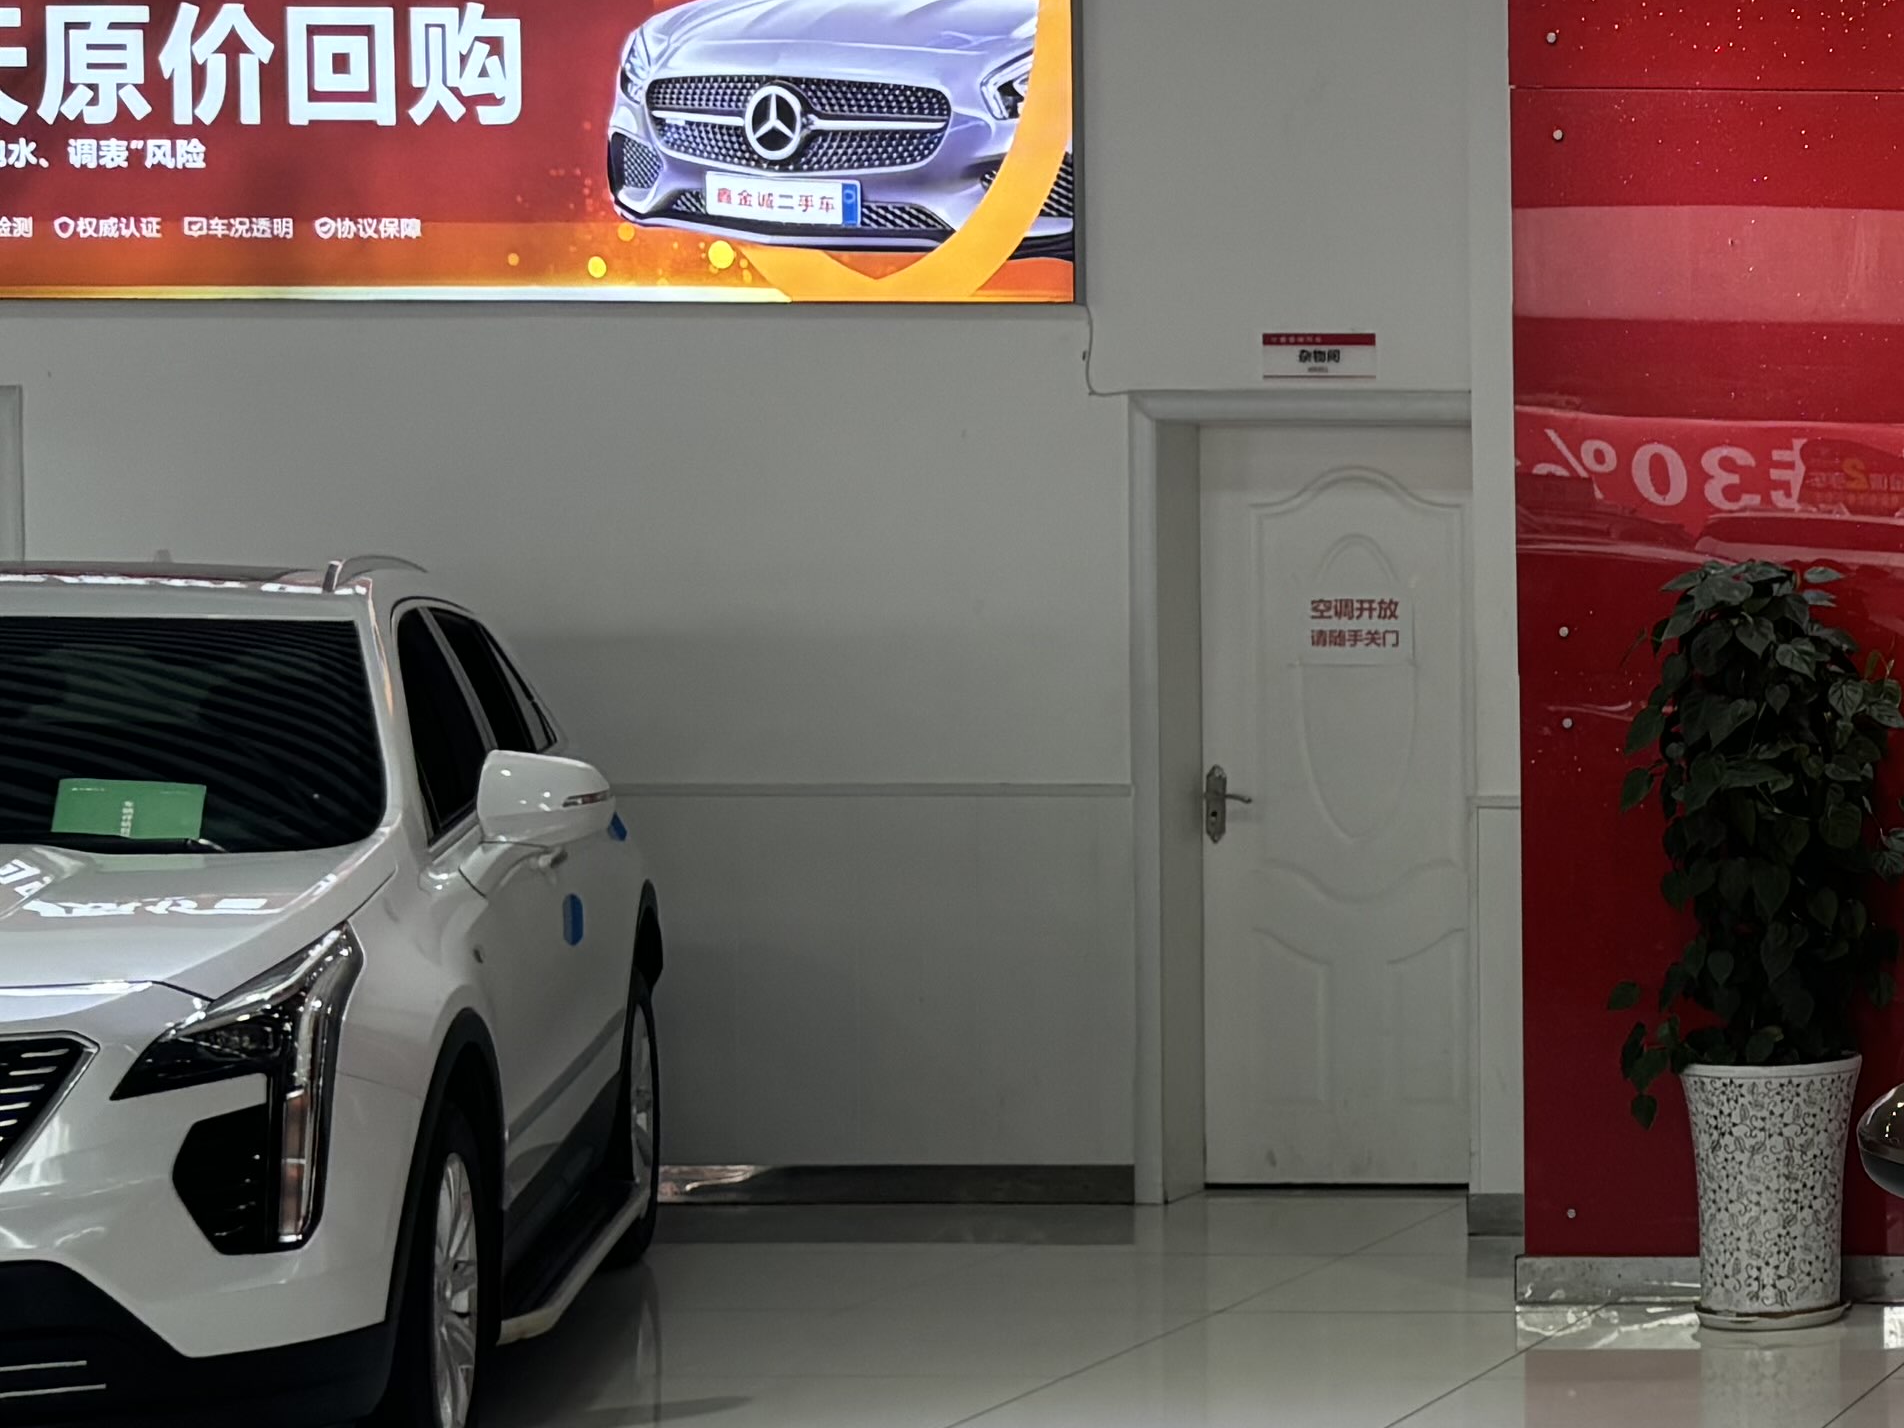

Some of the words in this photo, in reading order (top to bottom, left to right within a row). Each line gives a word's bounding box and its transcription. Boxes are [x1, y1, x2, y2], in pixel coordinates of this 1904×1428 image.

[0, 1, 523, 126] 原价回购
[76, 216, 162, 239] 权威认证
[207, 216, 294, 239] 车况透明
[336, 216, 422, 239] 协议保障
[1310, 598, 1400, 621] 空调开放
[1310, 628, 1400, 648] 请随手关门
